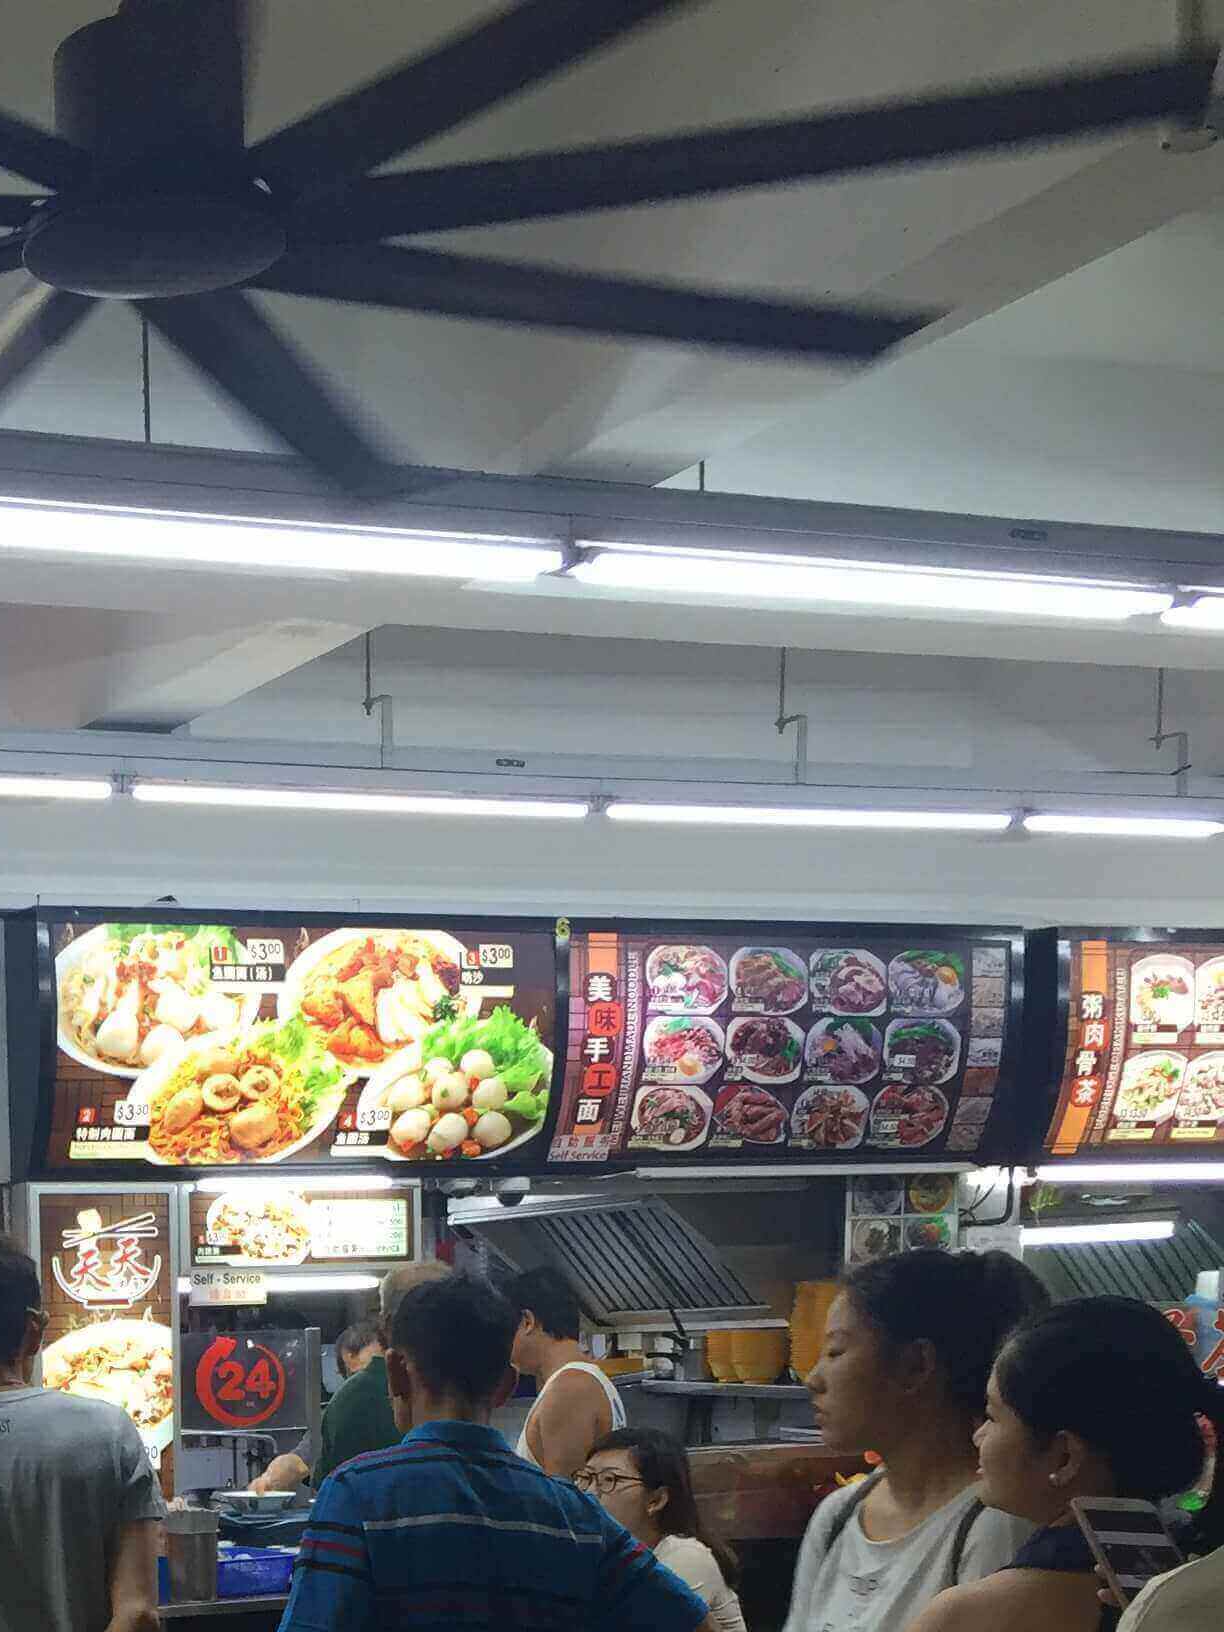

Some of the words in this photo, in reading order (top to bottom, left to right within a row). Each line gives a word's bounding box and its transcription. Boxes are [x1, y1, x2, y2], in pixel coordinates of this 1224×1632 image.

[556, 917, 571, 940] 6
[576, 975, 618, 1123] 美味手工面
[571, 1150, 607, 1161] Service
[193, 1273, 214, 1285] Self
[223, 1273, 261, 1285] Service
[216, 1357, 276, 1400] 24
